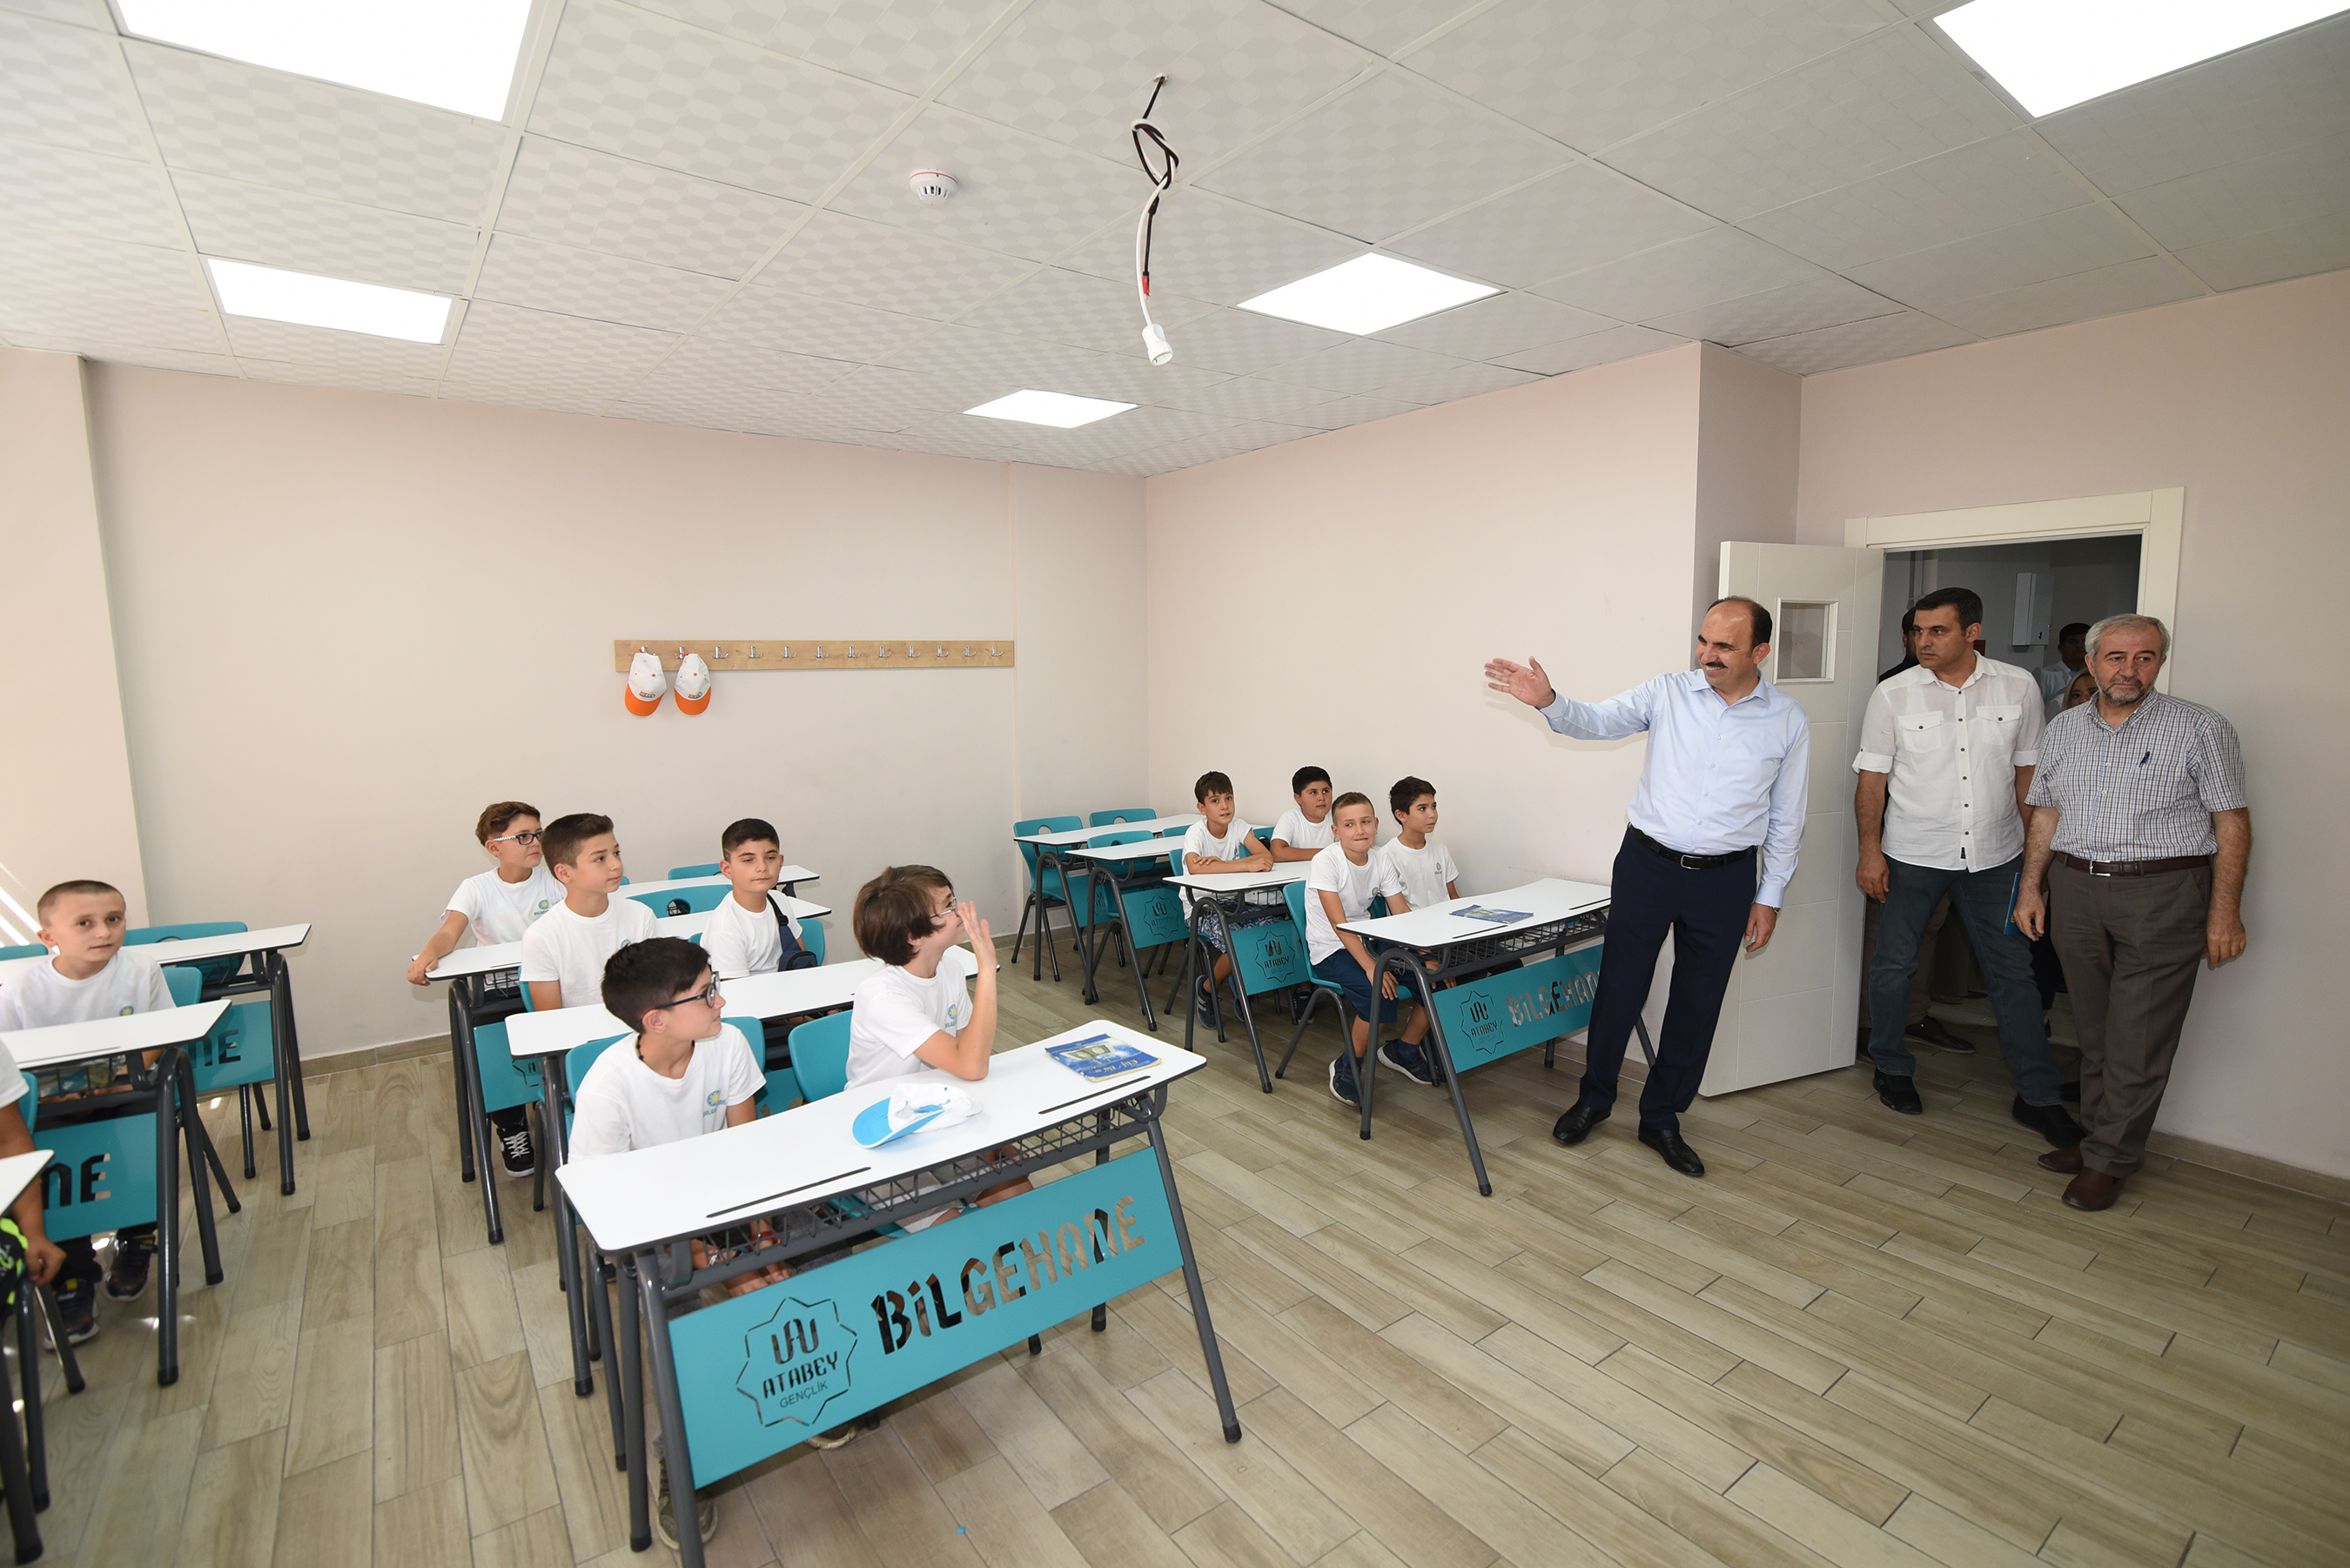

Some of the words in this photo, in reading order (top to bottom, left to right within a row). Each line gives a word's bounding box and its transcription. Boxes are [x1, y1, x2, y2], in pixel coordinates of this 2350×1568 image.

[1470, 1021, 1499, 1039] ATABEY
[762, 1350, 838, 1399] ATABEY
[779, 1380, 829, 1409] GENÇLİK
